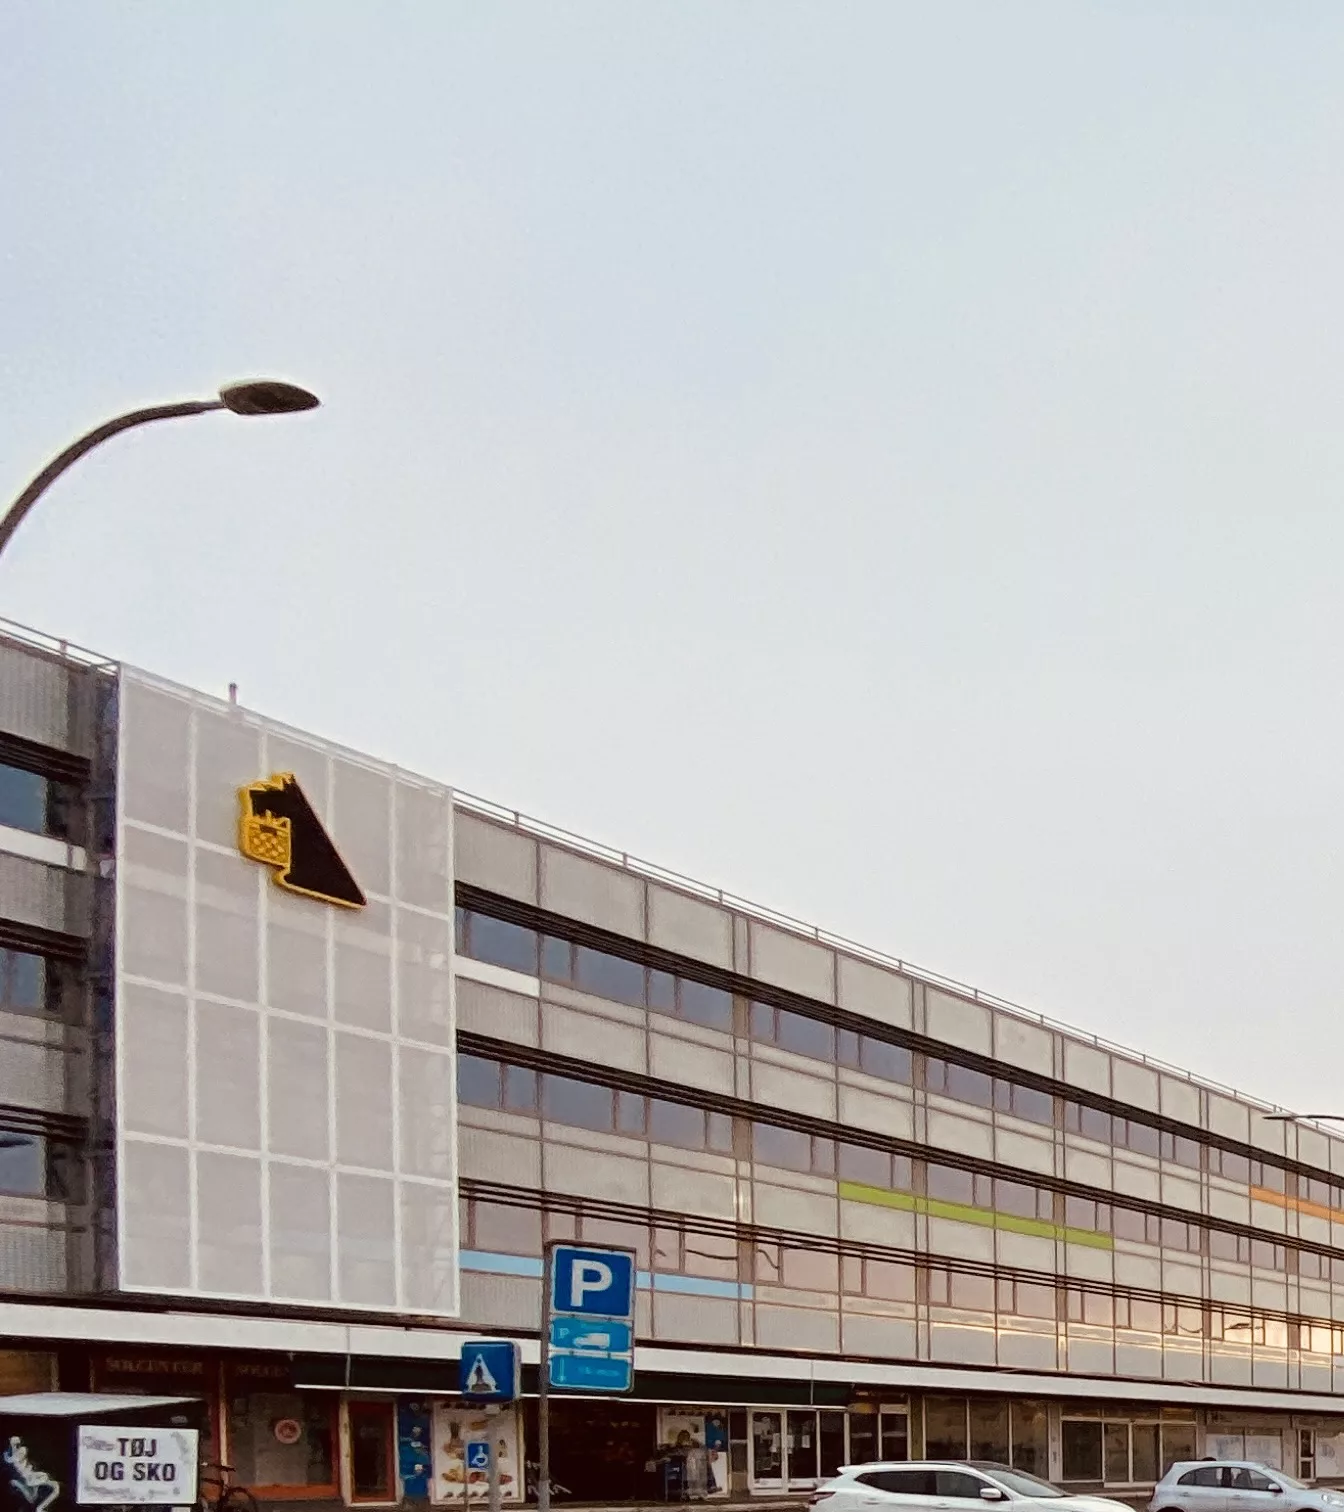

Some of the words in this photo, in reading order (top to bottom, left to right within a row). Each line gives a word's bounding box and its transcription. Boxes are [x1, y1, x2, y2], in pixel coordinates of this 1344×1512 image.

[571, 1258, 613, 1308] P
[117, 1437, 158, 1458] TØJ
[95, 1461, 124, 1481] OG
[132, 1462, 176, 1482] SKO
